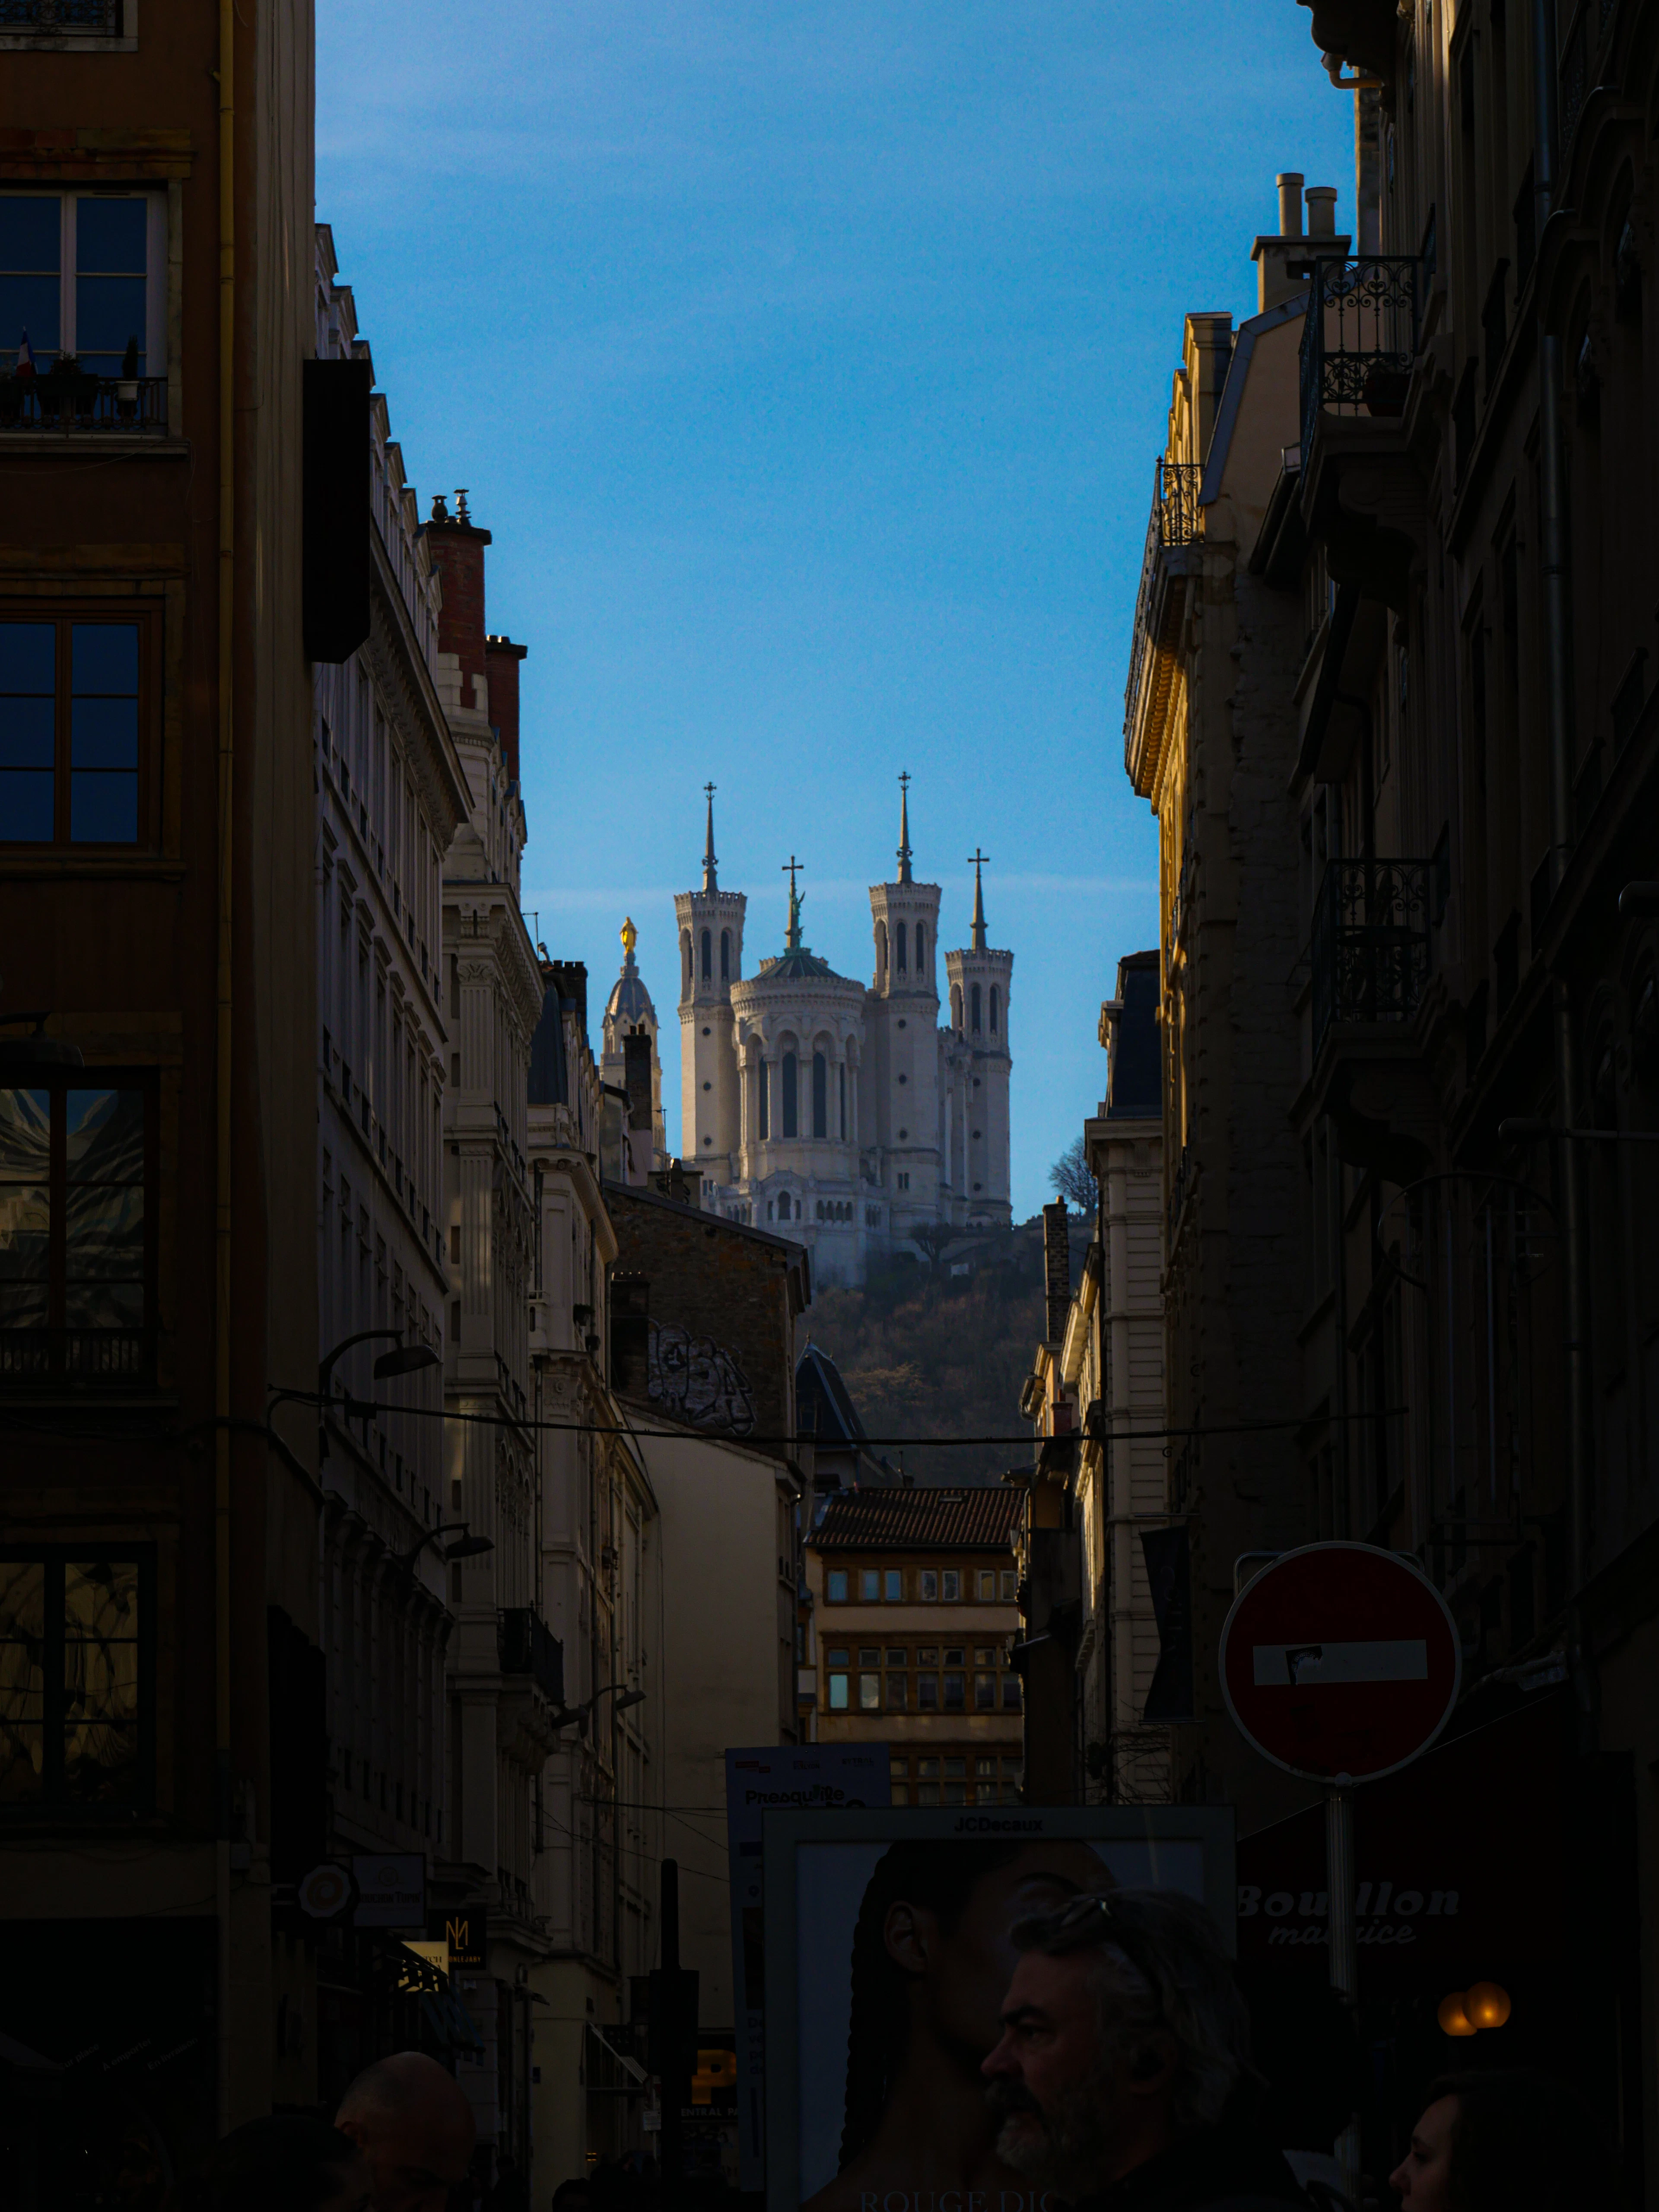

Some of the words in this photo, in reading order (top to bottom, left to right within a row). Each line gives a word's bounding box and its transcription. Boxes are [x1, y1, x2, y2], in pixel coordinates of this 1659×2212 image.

[954, 1817, 1043, 1832] JCDecaux
[359, 1894, 394, 1903] OUCHON
[1238, 1882, 1459, 1916] Boullon
[1268, 1919, 1417, 1945] maice
[75, 2043, 100, 2063] place
[111, 2038, 152, 2066] emporter
[147, 2059, 161, 2071] En
[159, 2037, 198, 2063] livraison
[681, 2107, 722, 2117] ENTRAL
[860, 2191, 988, 2212] ROUGE
